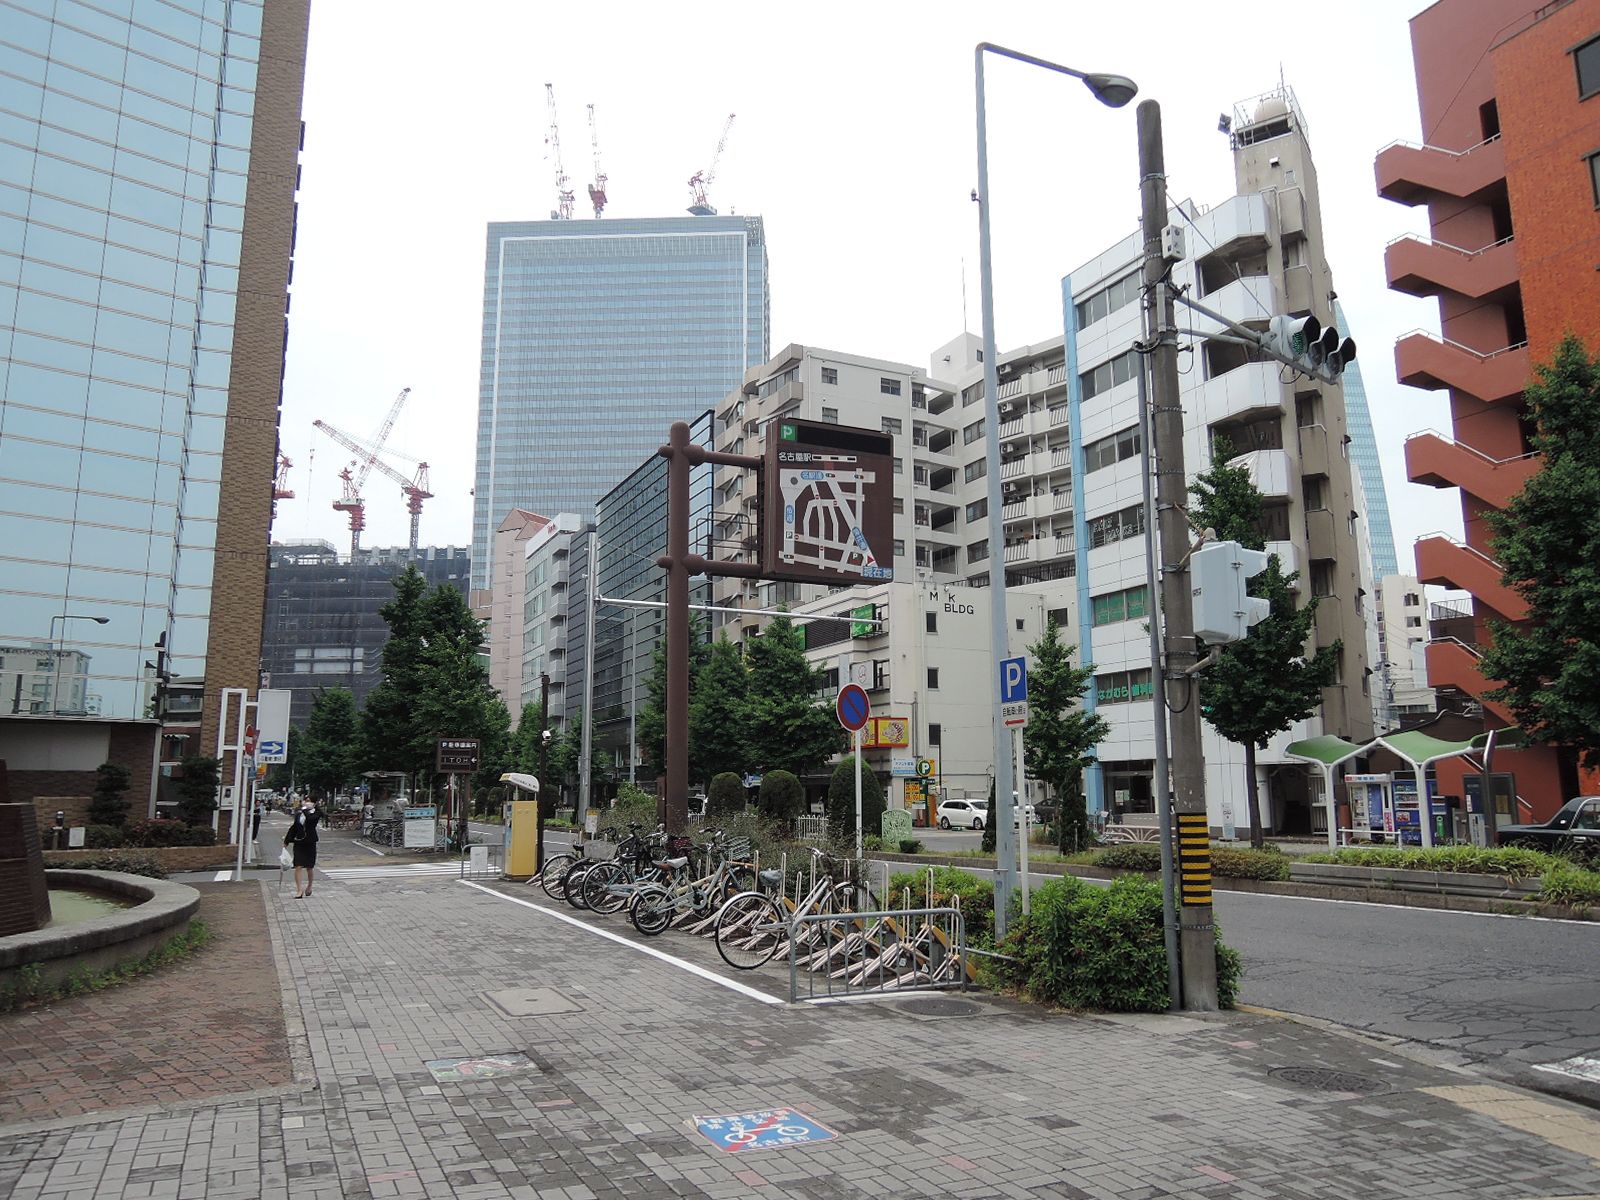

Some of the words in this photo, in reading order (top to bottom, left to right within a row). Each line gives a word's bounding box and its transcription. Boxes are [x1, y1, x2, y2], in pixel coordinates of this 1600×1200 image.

[783, 426, 793, 439] P
[778, 451, 812, 462] 名古屋駅
[864, 566, 892, 578] 現在地
[929, 591, 939, 601] M
[948, 593, 956, 603] K
[944, 603, 974, 615] BLDG
[1006, 662, 1021, 699] P
[921, 762, 930, 774] P
[747, 1135, 810, 1148] 名古屋市
